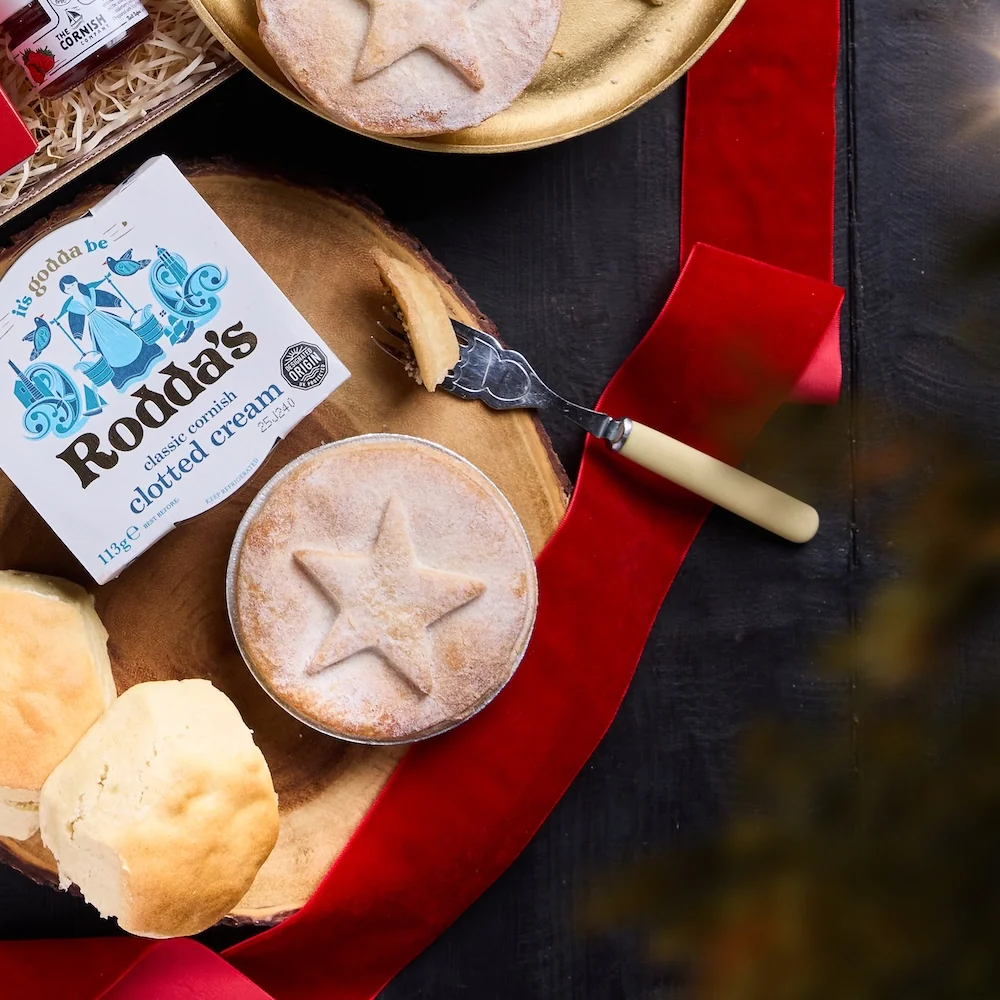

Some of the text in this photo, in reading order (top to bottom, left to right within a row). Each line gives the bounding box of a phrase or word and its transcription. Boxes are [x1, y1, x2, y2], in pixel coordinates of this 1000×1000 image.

[55, 28, 71, 41] THE
[59, 14, 107, 50] CORNISH
[80, 24, 110, 46] COMPANY
[12, 239, 109, 317] it's godda be
[284, 347, 313, 372] DESIGNATED
[289, 351, 322, 381] ORIGIN
[56, 320, 258, 489] Rodda's
[144, 389, 238, 471] classic cornish
[129, 384, 285, 515] clotted cream
[205, 458, 259, 504] KEEP REFRIGERATED
[143, 515, 157, 529] BEST
